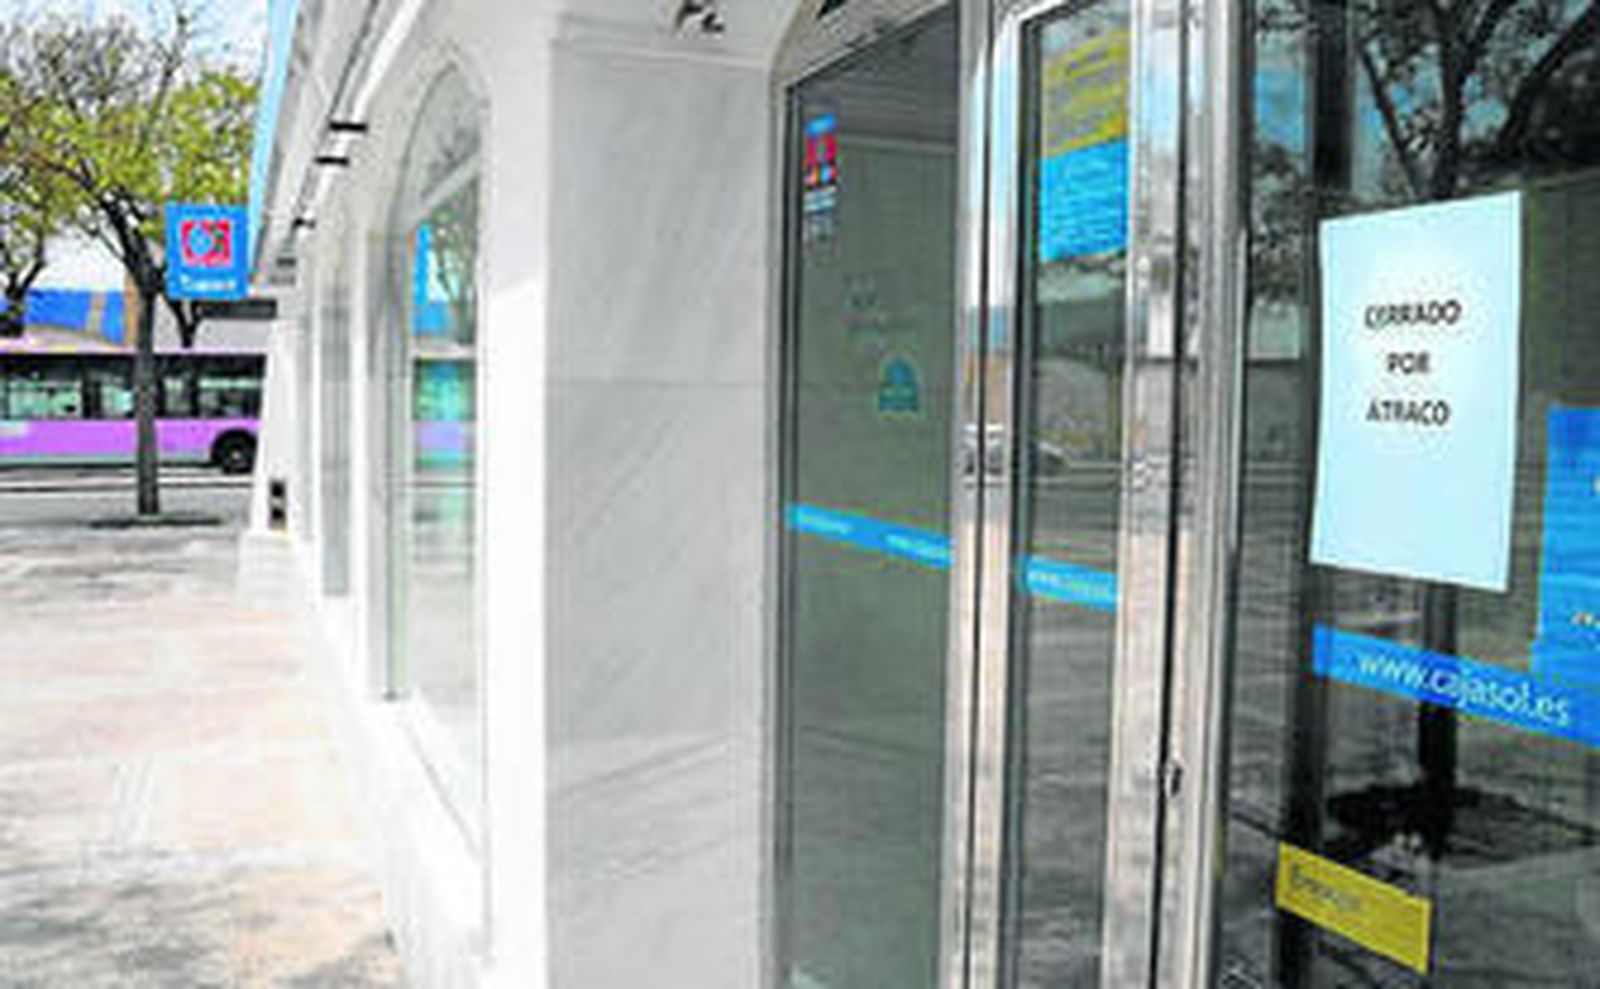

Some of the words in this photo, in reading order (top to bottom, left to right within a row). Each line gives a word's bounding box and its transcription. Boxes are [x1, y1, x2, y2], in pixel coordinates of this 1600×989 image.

[1364, 299, 1462, 330] CERRADO
[1386, 352, 1430, 375] POR
[1365, 399, 1451, 426] ATRACO
[1354, 652, 1570, 728] www.cajasol.es
